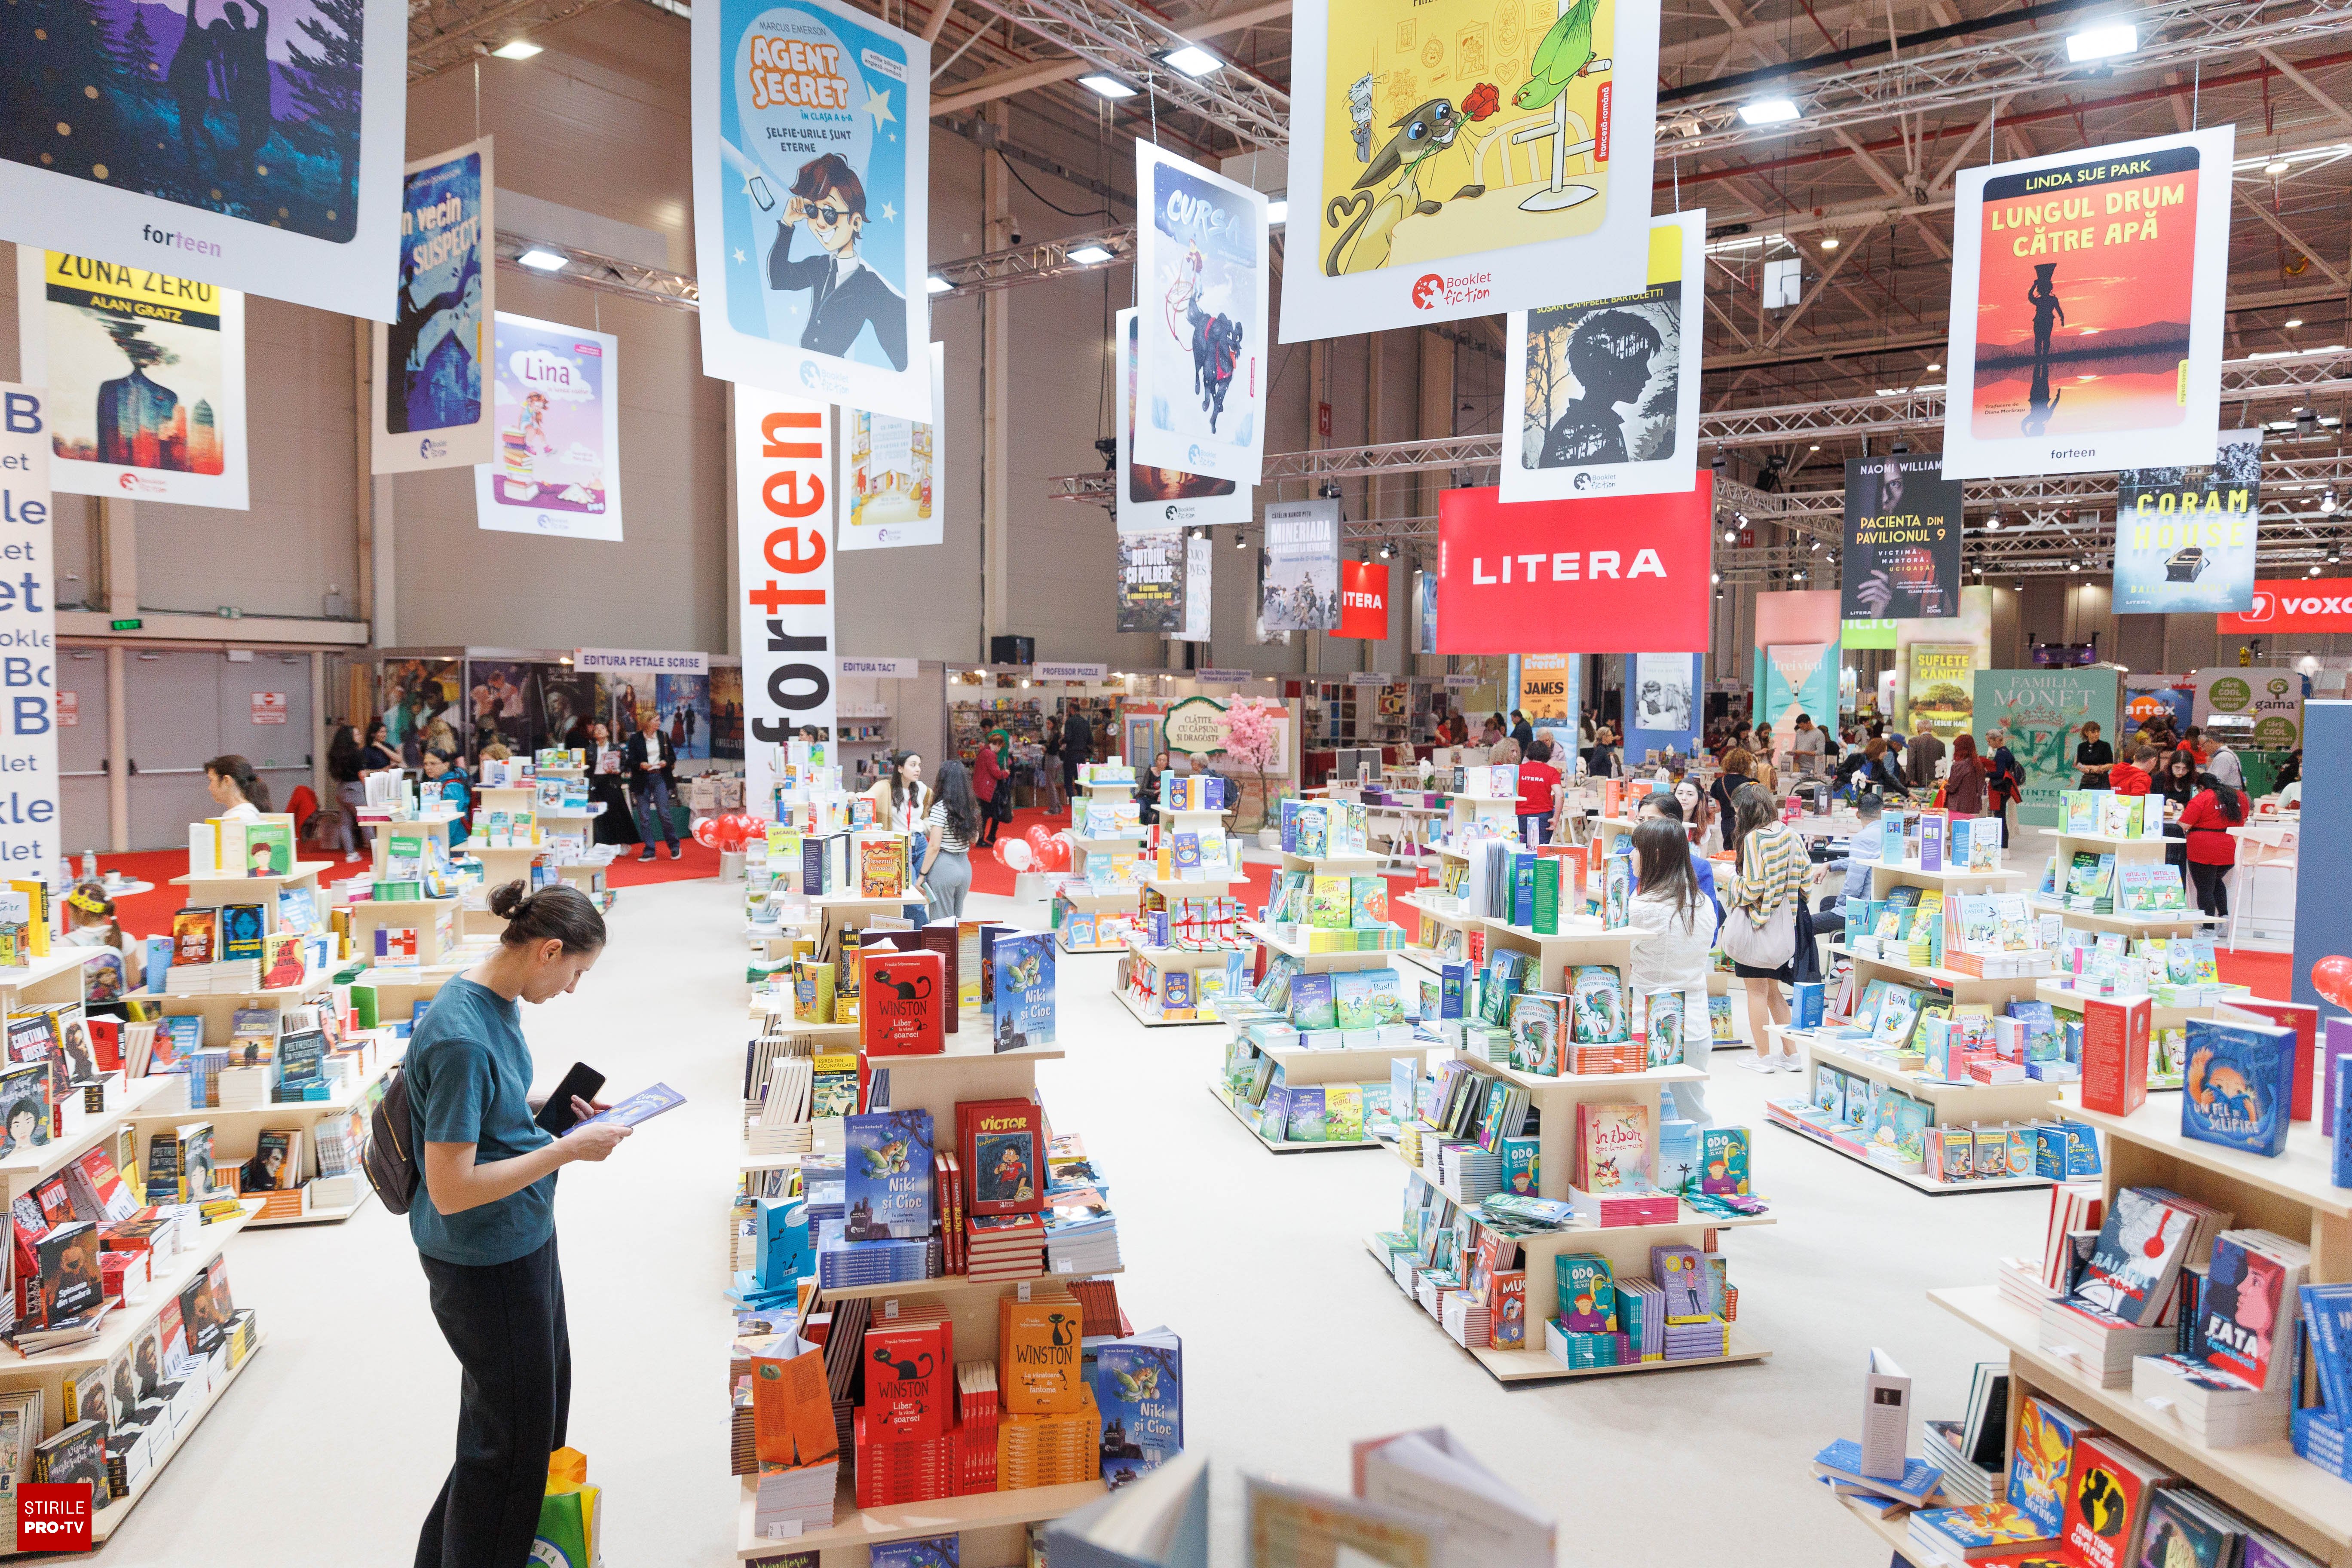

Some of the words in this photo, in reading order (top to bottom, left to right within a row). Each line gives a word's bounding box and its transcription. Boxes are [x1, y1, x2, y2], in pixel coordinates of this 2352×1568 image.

[759, 21, 790, 33] MARCUS
[792, 23, 826, 36] EMERSON
[750, 35, 839, 75] AGENT
[749, 67, 848, 110] SECRET
[800, 109, 809, 120] ÎN
[834, 113, 839, 121] A
[841, 113, 853, 122] 6-A
[1599, 86, 1610, 158] franceză-română
[766, 127, 827, 140] SELFIE-URILE
[829, 128, 851, 141] SUNT
[781, 142, 816, 153] ETERNE
[2025, 173, 2073, 191] LINDA
[2077, 166, 2106, 183] SUE
[2110, 159, 2151, 177] PARK
[417, 196, 462, 230] vecin
[1991, 196, 2095, 231] LUNGUL
[2105, 183, 2185, 216] DRUM
[1166, 188, 1241, 247] CURSA
[143, 224, 221, 258] forteen
[2012, 223, 2095, 258] CĂTRE
[2103, 210, 2158, 247] APĂ
[413, 215, 481, 276] SUSPECT
[57, 252, 132, 289] ZONA
[144, 272, 211, 302] ZERO
[1447, 272, 1491, 288] Booklet
[1443, 287, 1490, 307] fiction
[1565, 298, 1610, 310] CAMPBELL
[1611, 288, 1664, 305] BARTOLETTI
[90, 295, 132, 312] ALAN
[134, 303, 183, 323] GRATZ
[526, 358, 570, 386] Lina
[2051, 447, 2095, 459] forteen
[1860, 463, 1895, 475] NAOMI
[1590, 480, 1616, 490] fiction
[2137, 489, 2248, 517] CORAM
[1860, 514, 1921, 530] PACIENTA
[1927, 516, 1944, 526] DIN
[1271, 520, 1331, 544] MINERIADA
[1856, 529, 1930, 545] PAVILIONUL
[1936, 528, 1946, 541] 9
[2134, 522, 2247, 550] HOUSE
[1132, 548, 1167, 567] BUTOIUL
[1126, 568, 1137, 584] CU
[1138, 565, 1173, 583] PULBERE
[1473, 549, 1667, 585] LITERA
[749, 410, 830, 745] forteen
[1343, 591, 1382, 609] ITERA
[584, 655, 627, 666] EDITURA
[629, 656, 664, 667] PETALE
[667, 657, 700, 668] SCRISE
[842, 662, 876, 672] EDITURA
[878, 662, 896, 673] TACT
[1524, 658, 1565, 670] Everett
[1772, 659, 1796, 671] Trei
[1798, 658, 1822, 673] vieți
[1918, 654, 1969, 667] SUFLETE
[1042, 667, 1077, 677] PROFESSOR
[1078, 667, 1099, 677] PUZZLE
[1524, 681, 1564, 695] JAMES
[2011, 677, 2079, 688] FAMILIA
[1993, 689, 2095, 707] MONET
[2255, 700, 2295, 712] gama
[2125, 704, 2175, 715] artex
[1185, 714, 1212, 724] CLĂTITE
[1189, 724, 1219, 735] CĂPȘUNI
[1176, 735, 1183, 743] ȘI
[1184, 734, 1219, 743] DRAGOSTE
[868, 858, 893, 867] Deșertul
[1322, 886, 1338, 894] PISICI
[271, 958, 295, 967] NUME
[1374, 982, 1393, 992] Basti
[1025, 988, 1046, 1004] Niki
[1889, 991, 1906, 1006] LEON
[879, 1000, 927, 1016] WINSTON
[1020, 1006, 1029, 1025] și
[1030, 1004, 1052, 1019] Cioc
[893, 1019, 912, 1027] Liber
[11, 1025, 50, 1049] CORTINA
[894, 1032, 919, 1040] șoareci
[1820, 1072, 1834, 1087] LEON
[1332, 1098, 1351, 1108] PISICI
[2193, 1102, 2209, 1114] UN
[2212, 1102, 2230, 1117] FEL
[980, 1115, 1028, 1131] VICTOR
[2208, 1114, 2259, 1134] SCLIPIRE
[1592, 1119, 1608, 1145] În
[1610, 1124, 1643, 1143] zbor
[977, 1137, 1000, 1147] VAMPIRII
[1596, 1145, 1608, 1155] spre
[1609, 1143, 1627, 1152] lumea
[1627, 1142, 1643, 1150] mare
[1707, 1136, 1729, 1147] ODO
[1511, 1148, 1534, 1160] ODO
[889, 1176, 916, 1192] Niki
[882, 1194, 893, 1215] și
[896, 1192, 922, 1209] Cioc
[943, 1207, 951, 1233] VICTOR
[1572, 1267, 1593, 1279] ODO
[2092, 1250, 2153, 1289] BĂIATUL
[58, 1281, 88, 1298] Spioana
[2089, 1265, 2145, 1302] facebook
[56, 1297, 67, 1309] din
[68, 1286, 92, 1305] umbră
[2208, 1315, 2259, 1358] FATA
[1015, 1344, 1073, 1365] WINSTON
[2207, 1336, 2257, 1371] facebook
[878, 1380, 929, 1399] WINSTON
[1029, 1385, 1056, 1393] fantome
[893, 1402, 913, 1410] Liber
[1140, 1402, 1165, 1419] Niki
[894, 1415, 920, 1424] șoareci
[1134, 1419, 1144, 1436] și
[1148, 1419, 1172, 1436] Cioc
[67, 1439, 87, 1456] Visul
[2076, 1522, 2092, 1543] MAI
[2092, 1534, 2116, 1559] TARE
[2089, 1544, 2115, 1568] FILME
